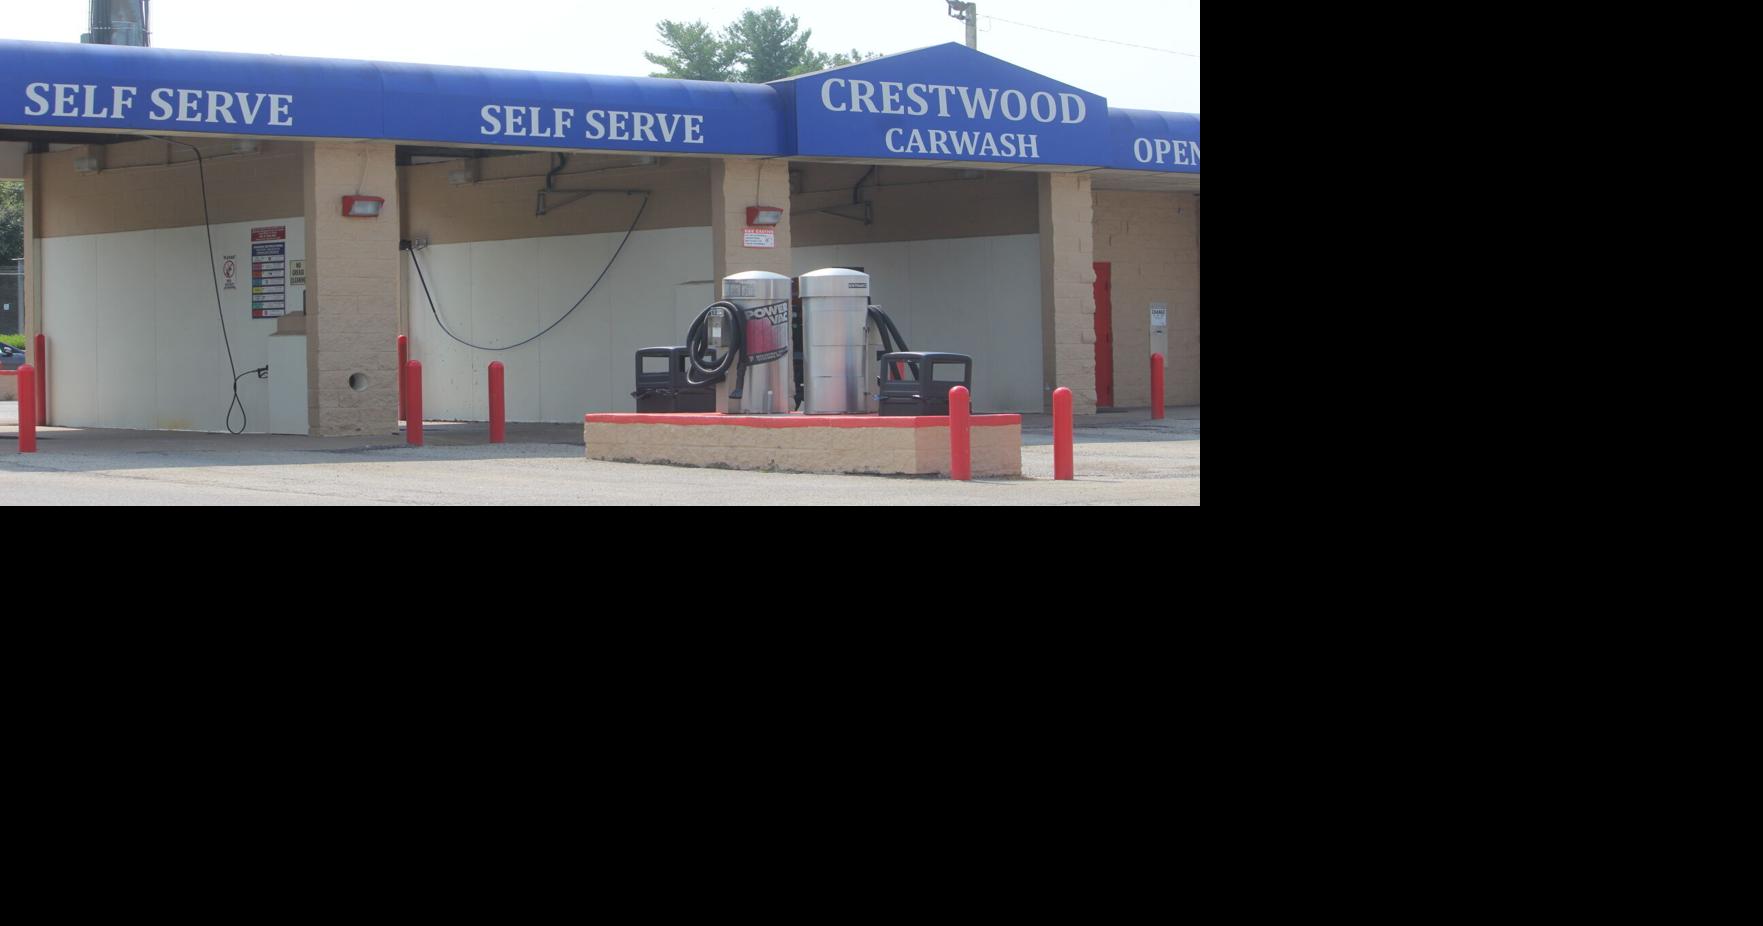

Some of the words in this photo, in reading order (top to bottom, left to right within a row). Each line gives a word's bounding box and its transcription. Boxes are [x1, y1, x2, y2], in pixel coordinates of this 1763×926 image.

[25, 83, 137, 119] SELF
[150, 88, 293, 126] SERVE
[821, 78, 1086, 124] CRESTWOOD
[480, 104, 575, 138] SELF
[586, 110, 704, 144] SERVE
[886, 128, 1040, 158] CARWASH
